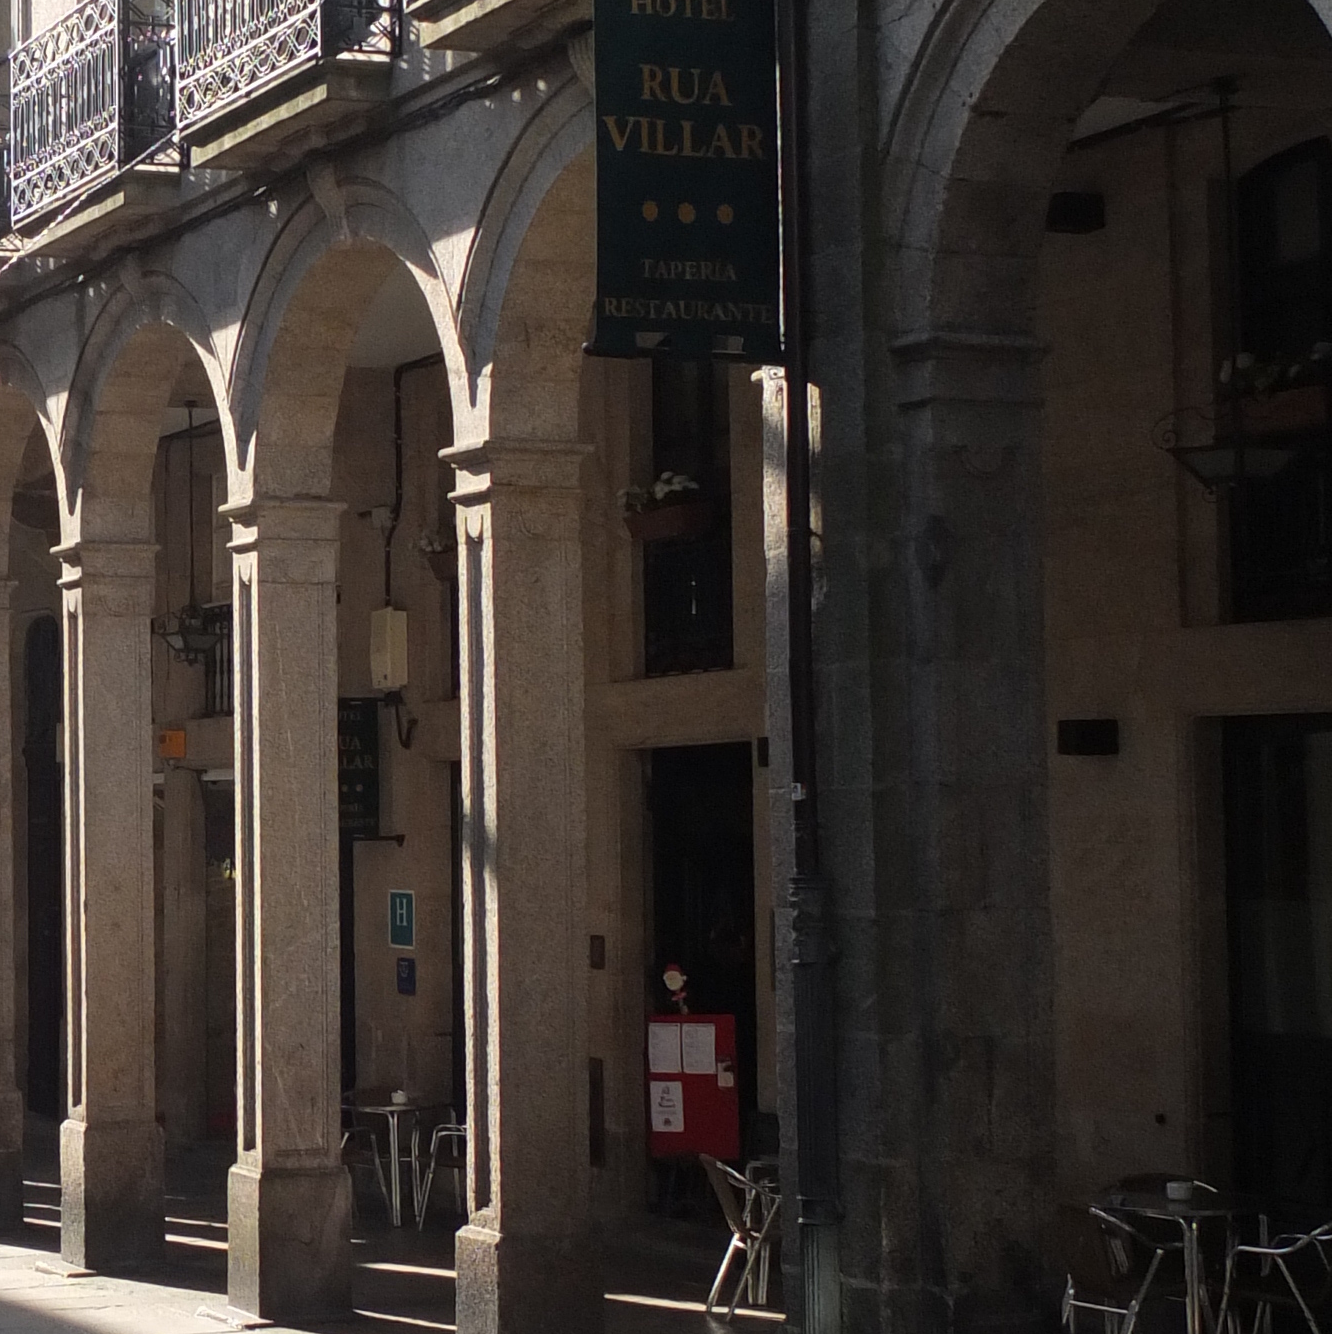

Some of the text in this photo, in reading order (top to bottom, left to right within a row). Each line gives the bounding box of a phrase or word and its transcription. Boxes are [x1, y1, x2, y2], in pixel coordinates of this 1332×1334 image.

[639, 63, 732, 107] RUA
[602, 115, 764, 159] VILLAR
[604, 296, 775, 324] RESTAURANTE
[339, 735, 362, 750] UA
[396, 897, 408, 927] H
